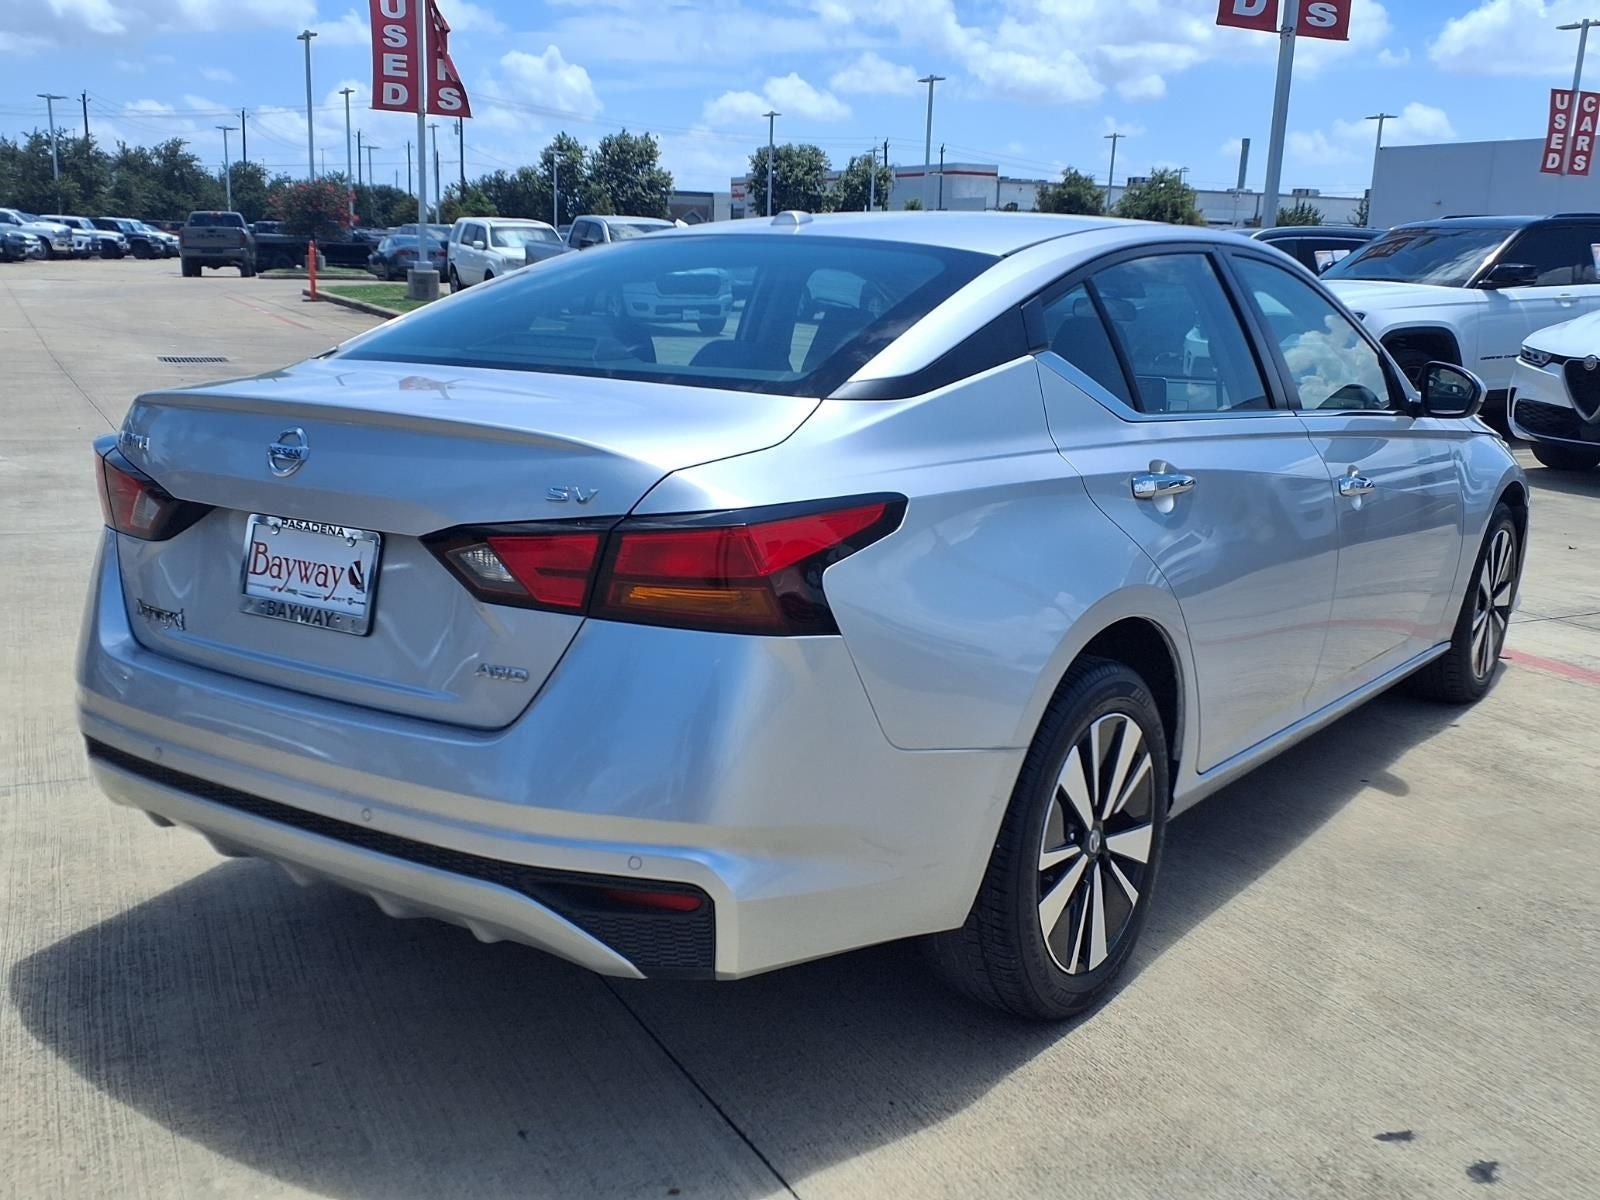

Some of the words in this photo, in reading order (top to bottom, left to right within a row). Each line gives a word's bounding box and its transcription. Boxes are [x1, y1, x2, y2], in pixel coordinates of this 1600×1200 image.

[380, 0, 409, 106] USED
[1545, 93, 1570, 169] USED
[1572, 96, 1597, 171] CARS
[545, 486, 599, 505] SV
[281, 518, 345, 537] PASADENA
[249, 541, 345, 601] Bayway
[266, 600, 334, 627] BAYWAY
